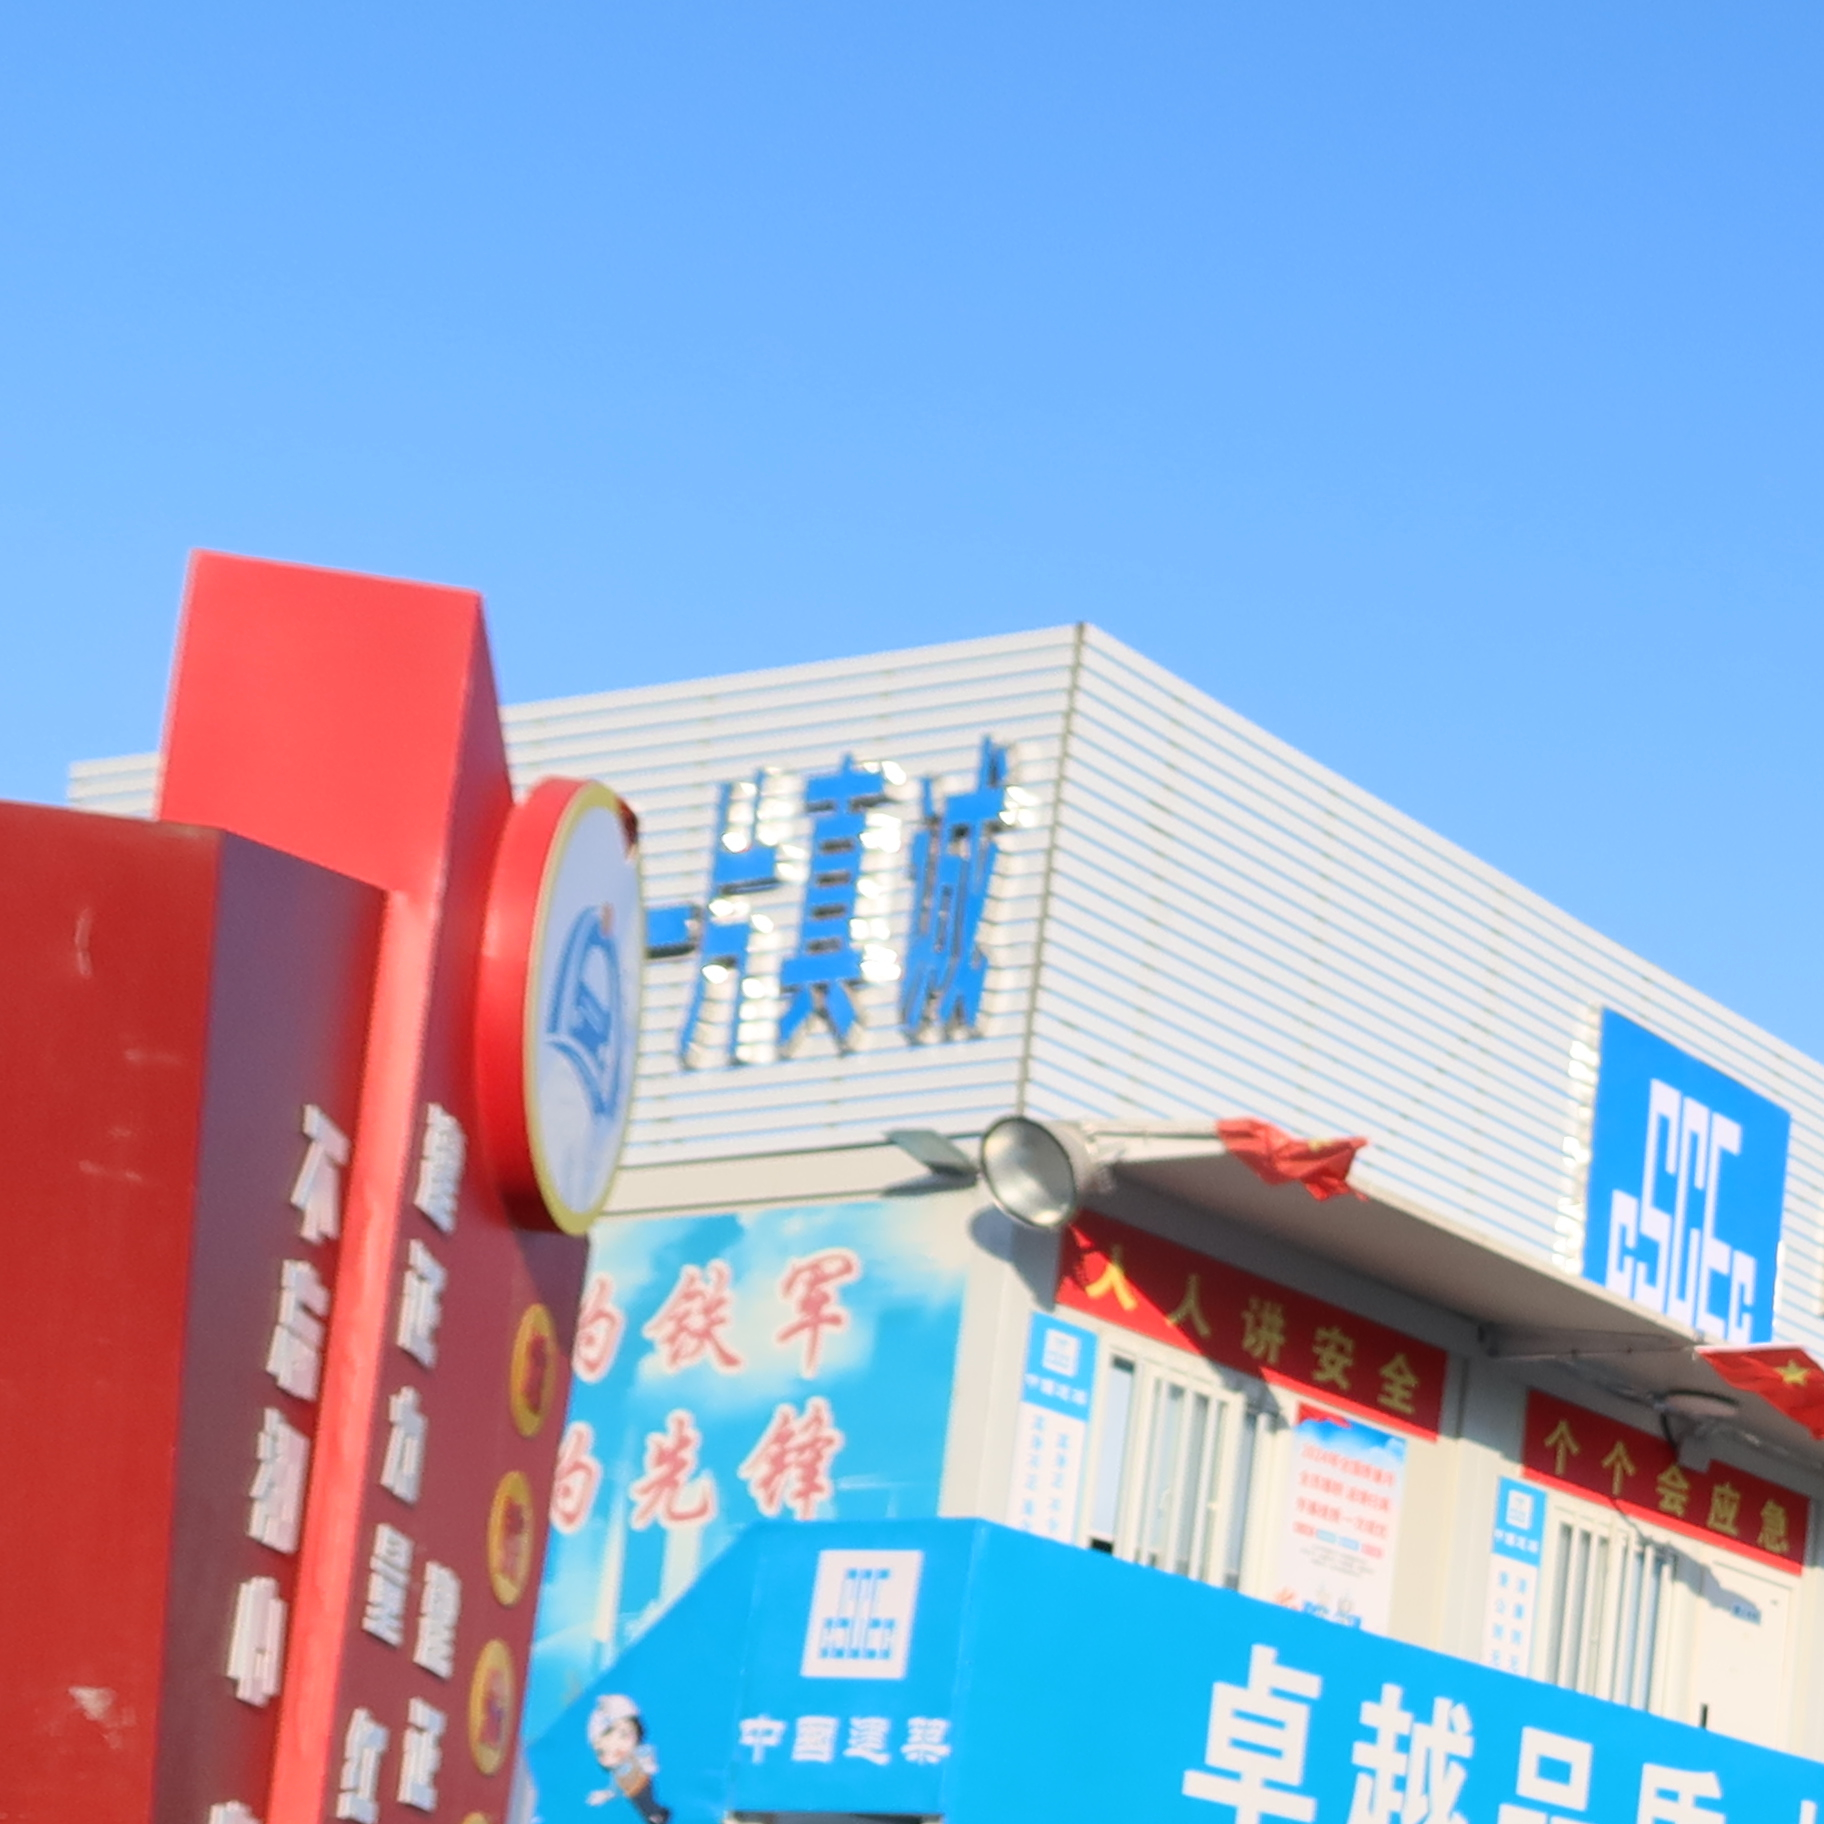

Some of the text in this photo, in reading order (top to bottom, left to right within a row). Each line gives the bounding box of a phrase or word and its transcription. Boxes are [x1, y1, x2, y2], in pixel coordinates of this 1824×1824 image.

[1084, 1244, 1420, 1417] 人人讲安全
[1544, 1418, 1790, 1554] 个个会应急
